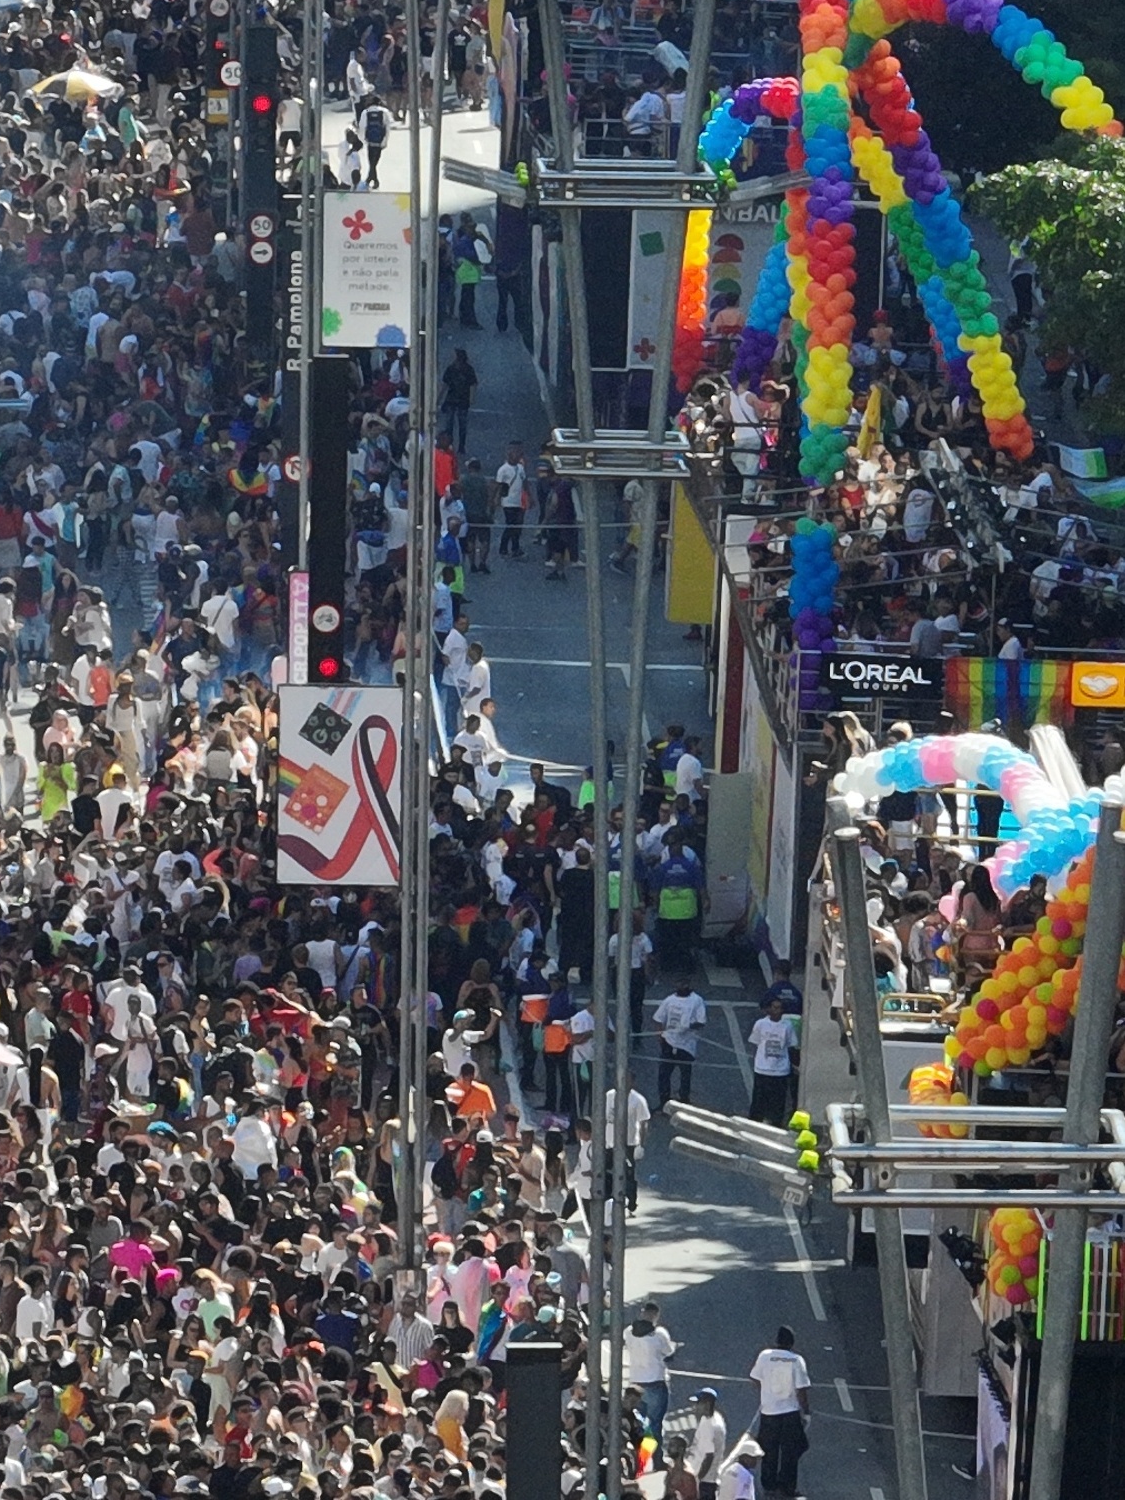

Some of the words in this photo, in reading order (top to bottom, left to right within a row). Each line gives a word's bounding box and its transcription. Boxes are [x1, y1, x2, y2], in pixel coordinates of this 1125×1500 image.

[225, 67, 241, 80] 50
[253, 219, 271, 231] 50
[343, 240, 398, 250] Queremos
[342, 256, 360, 264] por
[364, 255, 398, 263] inteiro
[352, 267, 372, 277] não
[375, 267, 399, 278] pela
